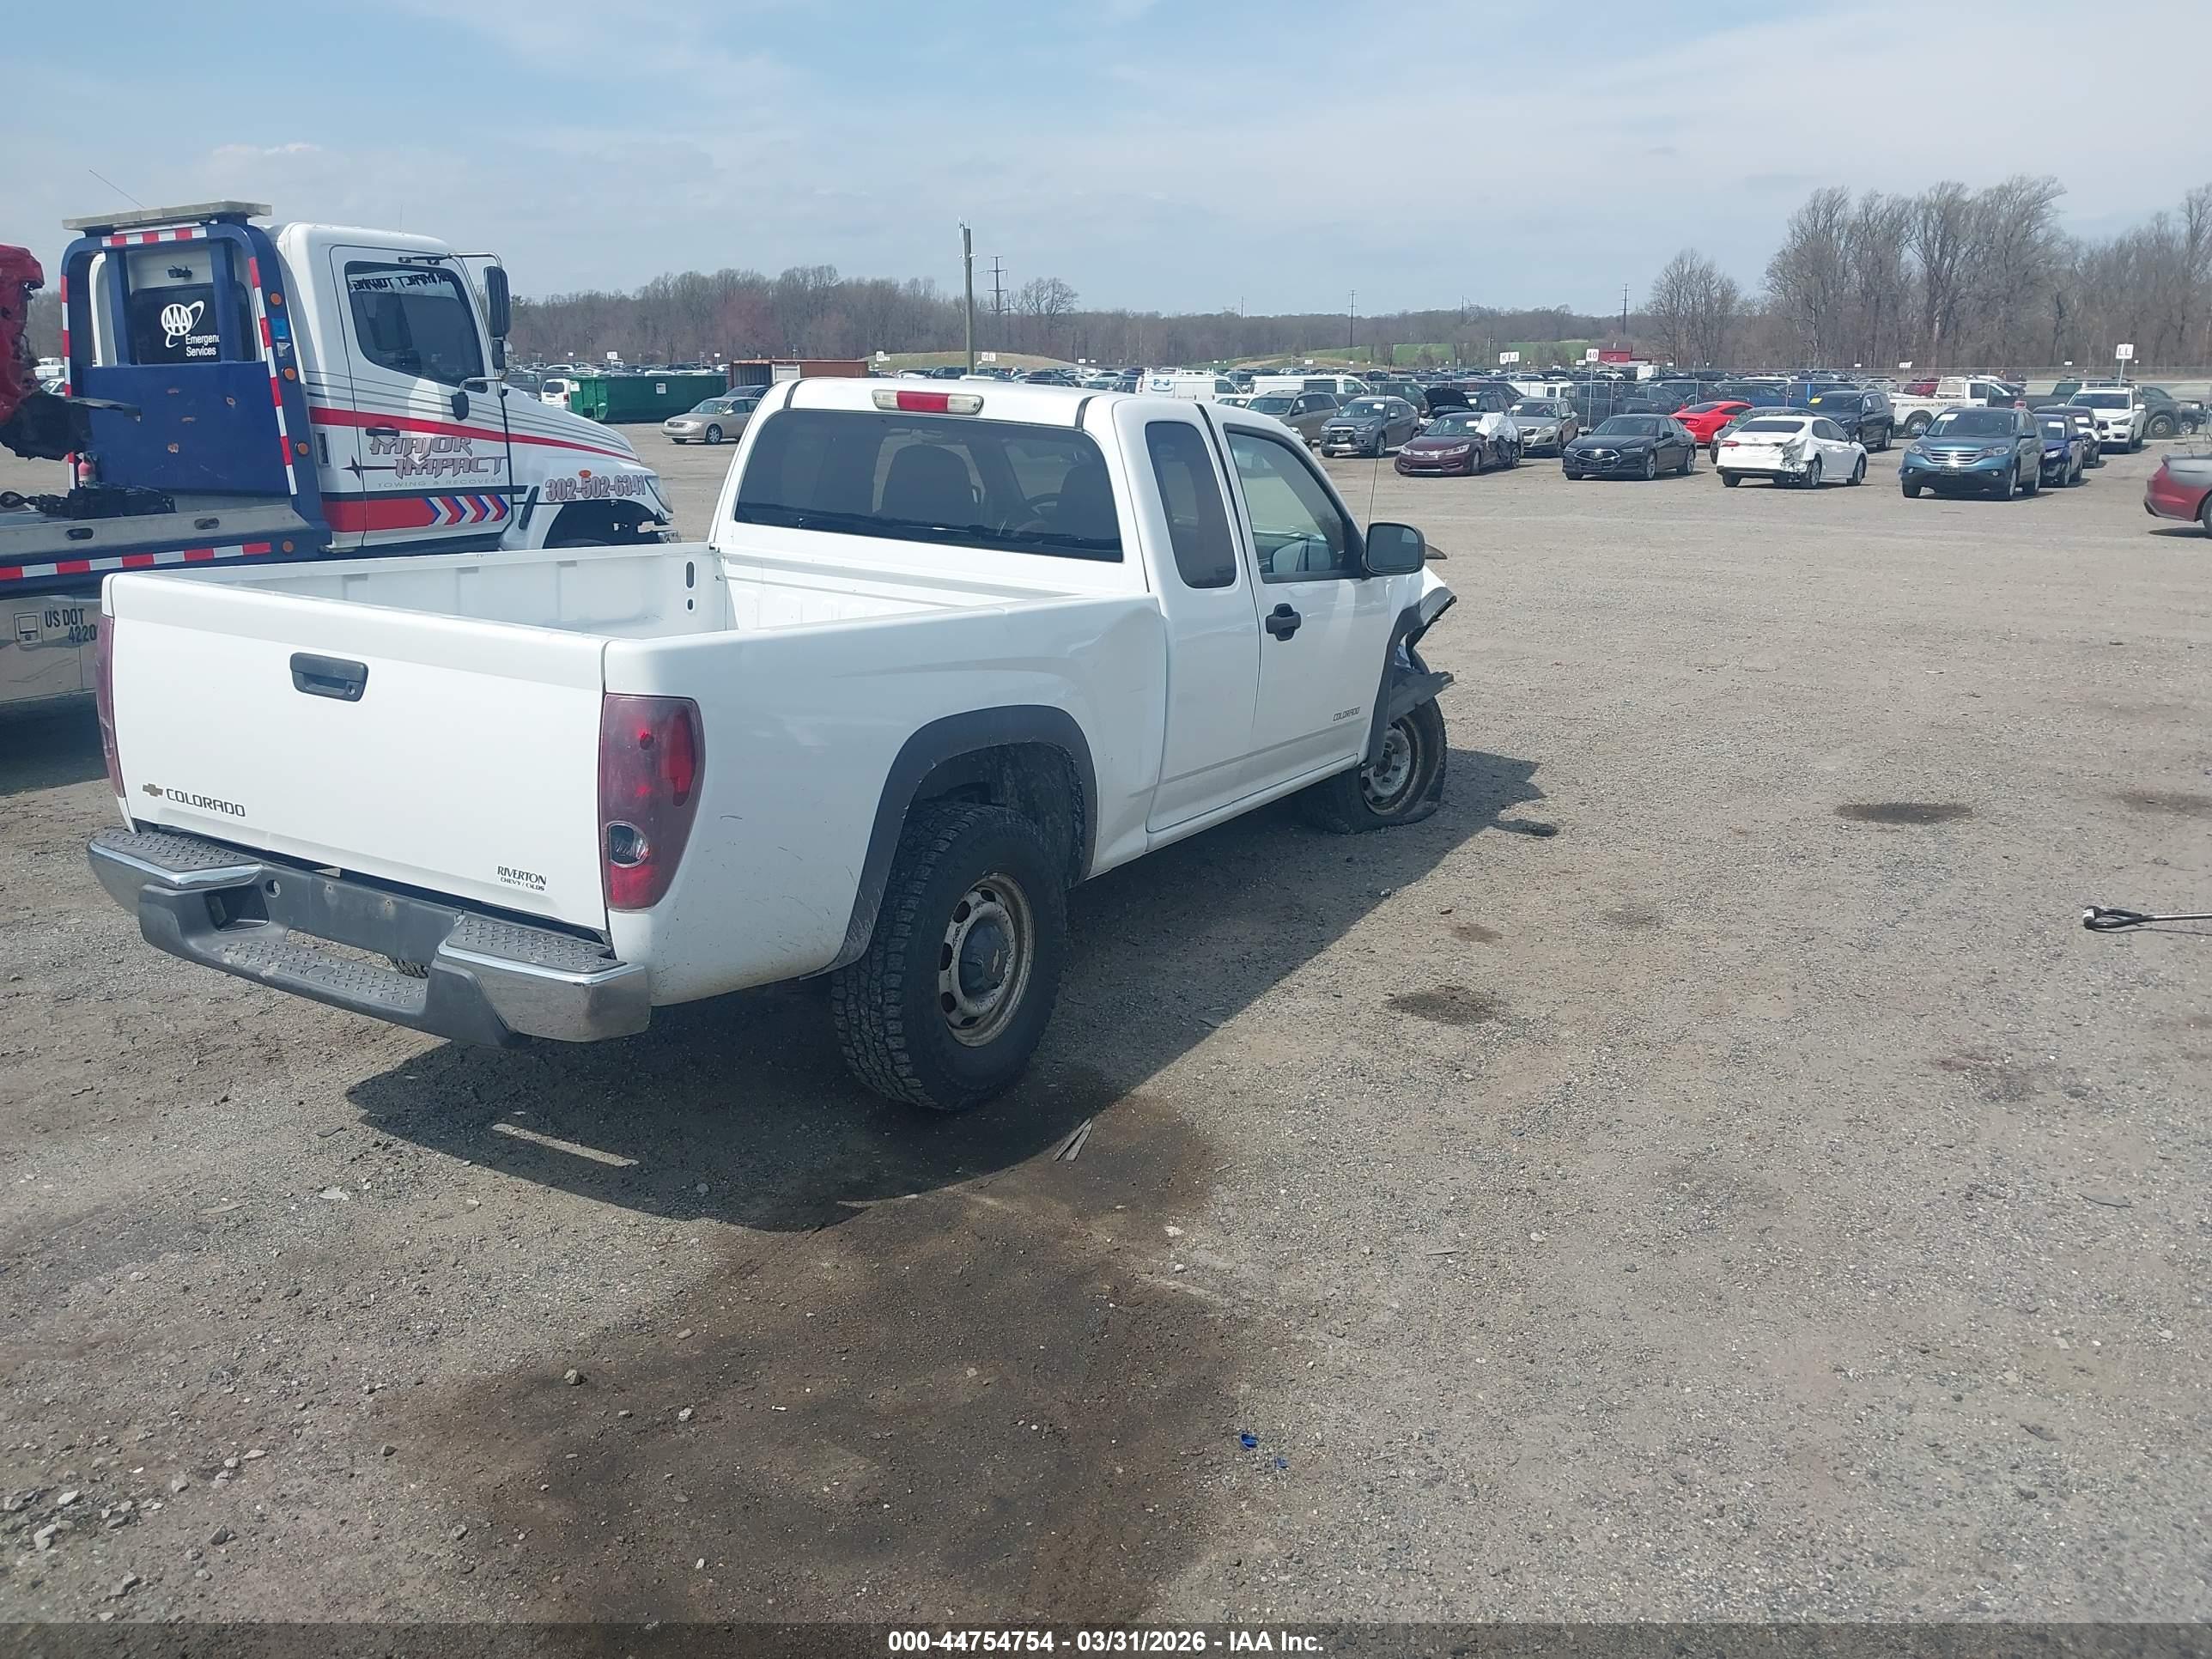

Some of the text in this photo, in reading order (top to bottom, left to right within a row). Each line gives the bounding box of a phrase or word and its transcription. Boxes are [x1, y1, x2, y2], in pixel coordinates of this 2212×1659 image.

[163, 305, 191, 335] AAA
[185, 334, 220, 346] Emergenc
[185, 346, 216, 357] Services
[369, 435, 473, 461] MAJOR
[395, 456, 507, 479] IMPACT
[545, 475, 646, 501] 302-502-6341
[45, 608, 84, 628] US DOT
[69, 624, 97, 643] 4220
[167, 788, 246, 817] COLORADO
[497, 866, 546, 885] RIVERTON
